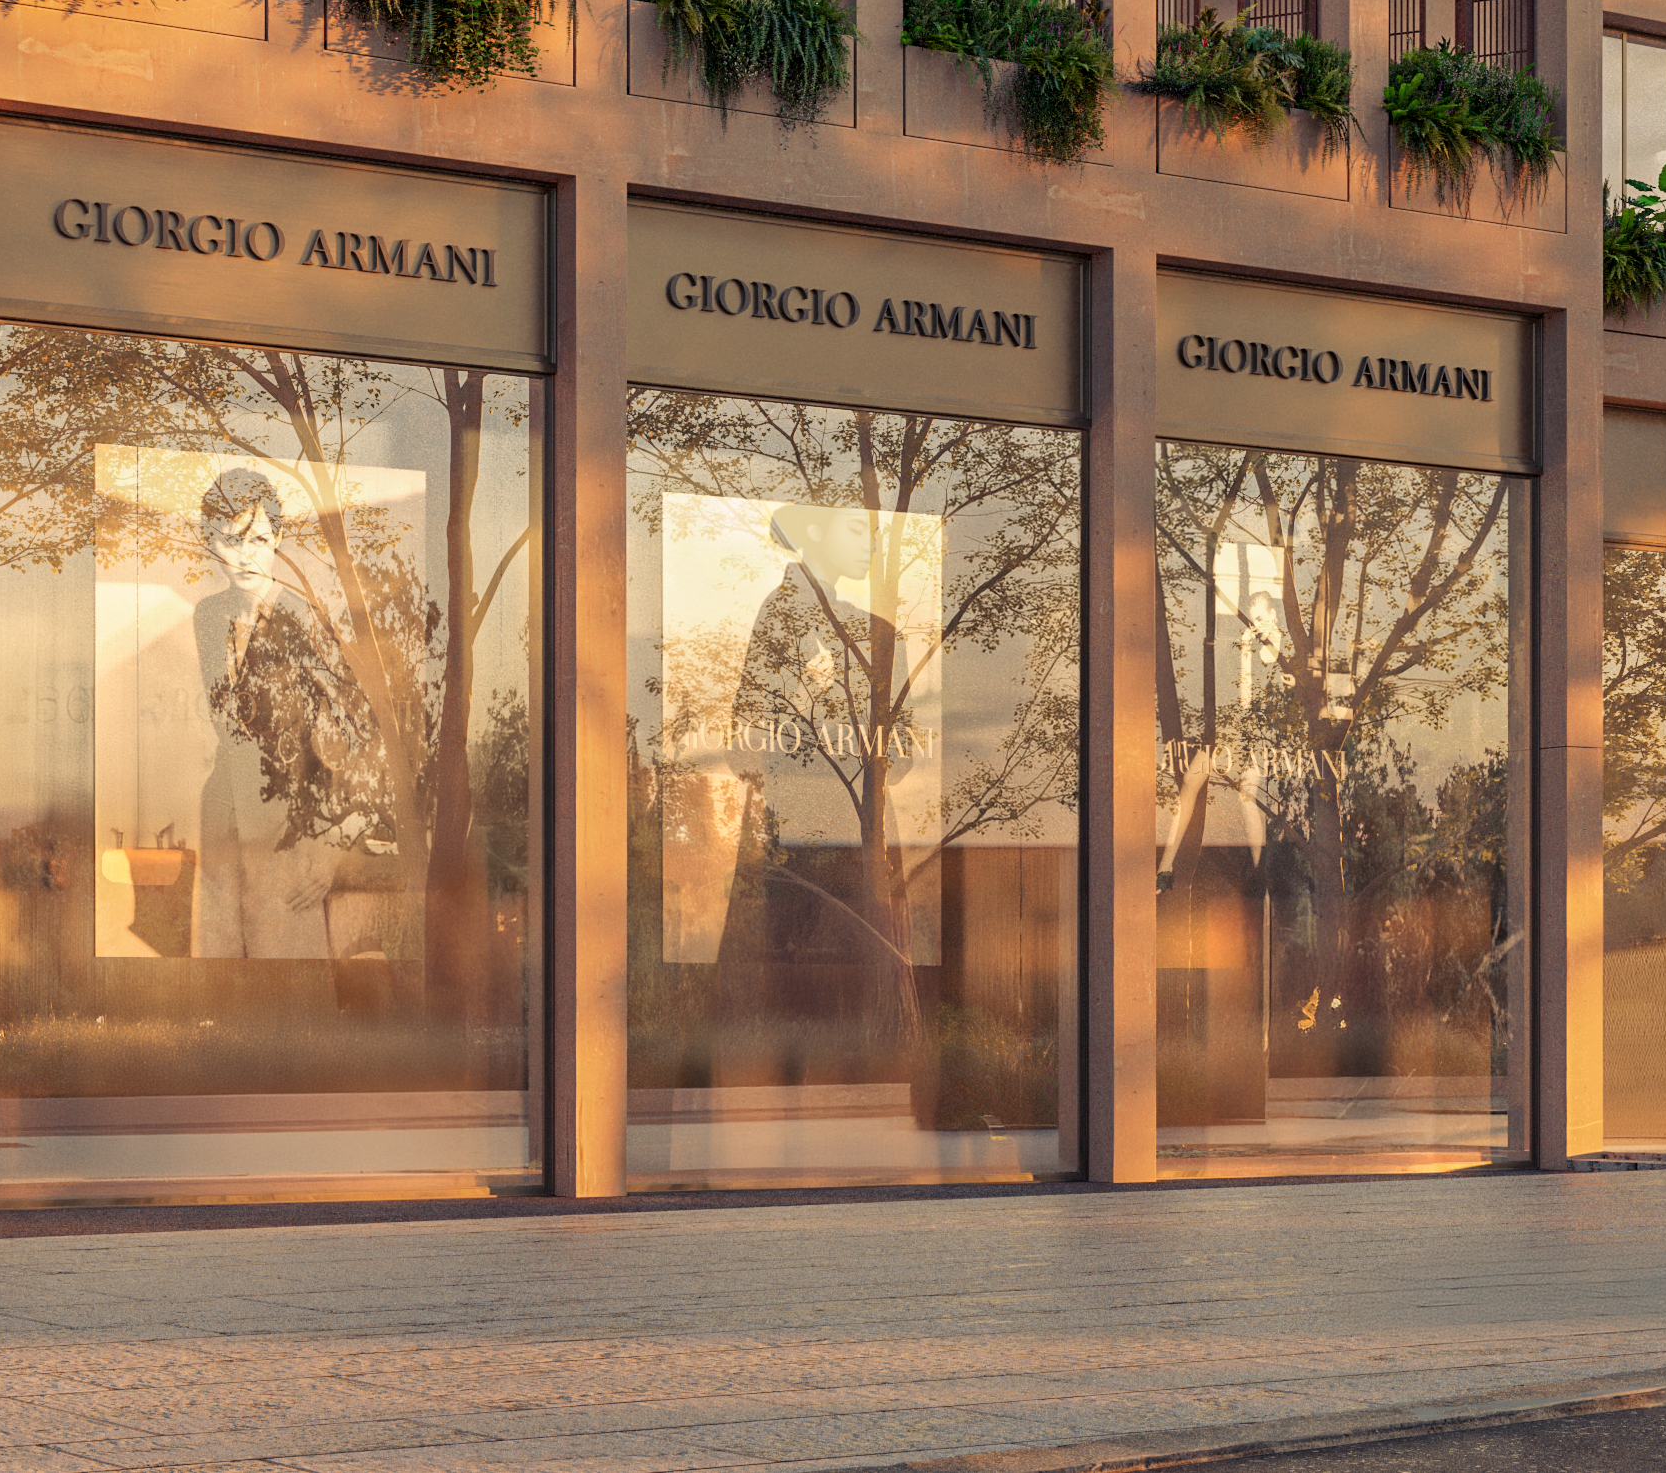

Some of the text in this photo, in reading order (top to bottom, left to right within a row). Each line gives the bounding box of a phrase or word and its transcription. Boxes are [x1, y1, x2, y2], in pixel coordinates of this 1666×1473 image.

[52, 198, 499, 287] GIORGIO ARMANI
[665, 272, 1039, 349] GIORGIO ARMANI
[1176, 334, 1495, 402] GIORGIO ARMANI
[669, 717, 934, 759] IORGIO ARMANI
